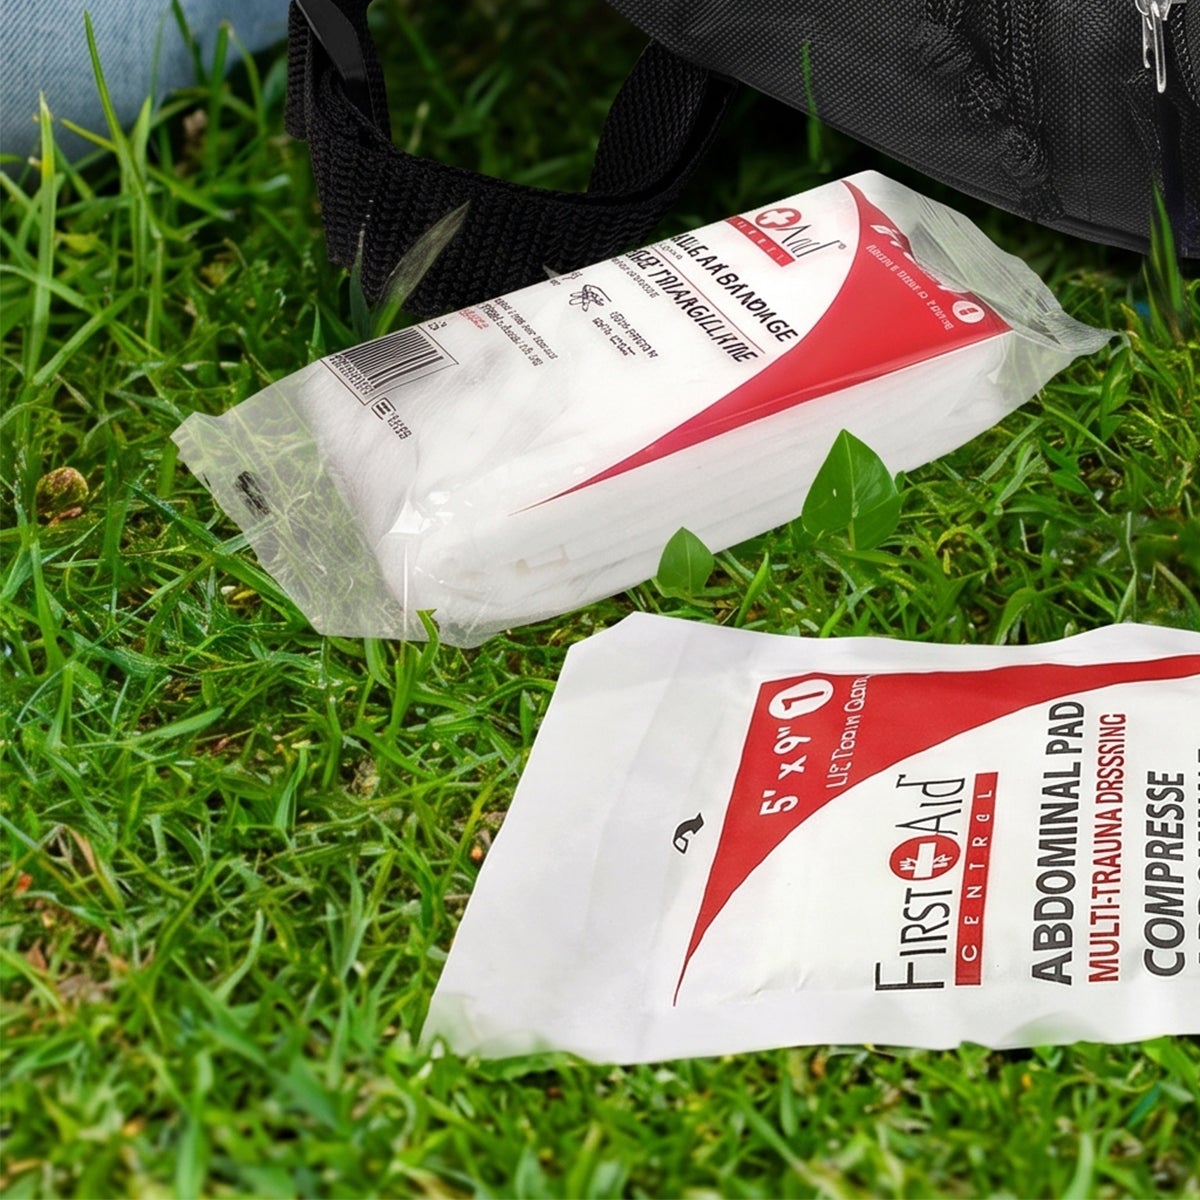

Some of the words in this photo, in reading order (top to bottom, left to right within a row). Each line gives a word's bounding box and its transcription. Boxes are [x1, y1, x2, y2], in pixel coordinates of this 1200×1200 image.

[1045, 701, 1085, 755] PAD
[874, 887, 953, 991] FIRST
[1031, 761, 1082, 986] ABDOMINAL
[1088, 807, 1123, 984] MULTI-TRAUNA
[1143, 770, 1186, 977] COMPRESSE
